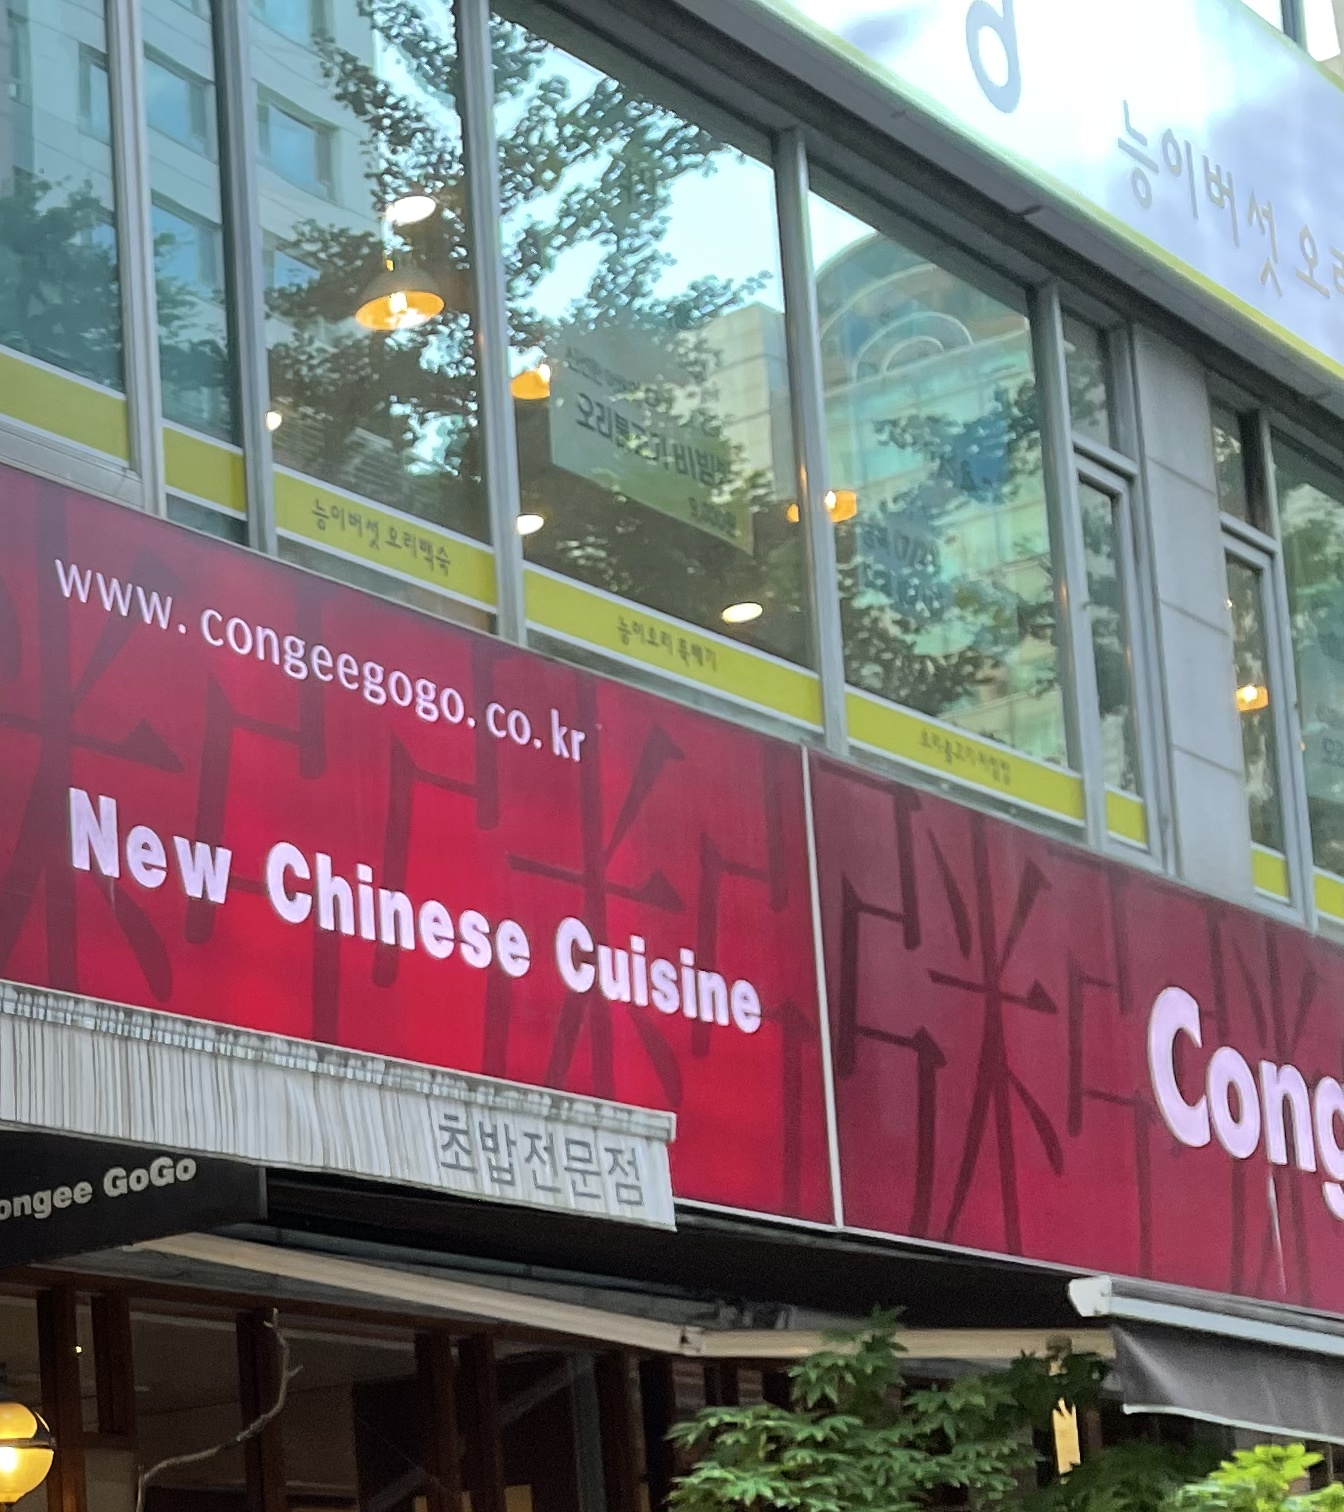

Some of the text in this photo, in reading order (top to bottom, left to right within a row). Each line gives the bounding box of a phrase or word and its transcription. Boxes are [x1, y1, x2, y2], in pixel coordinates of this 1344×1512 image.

[1118, 100, 1282, 297] 능이버섯
[68, 786, 762, 1034] New Chinese Cuisine
[103, 1155, 197, 1197] GoGo
[437, 1110, 646, 1208] 초밥전문점
